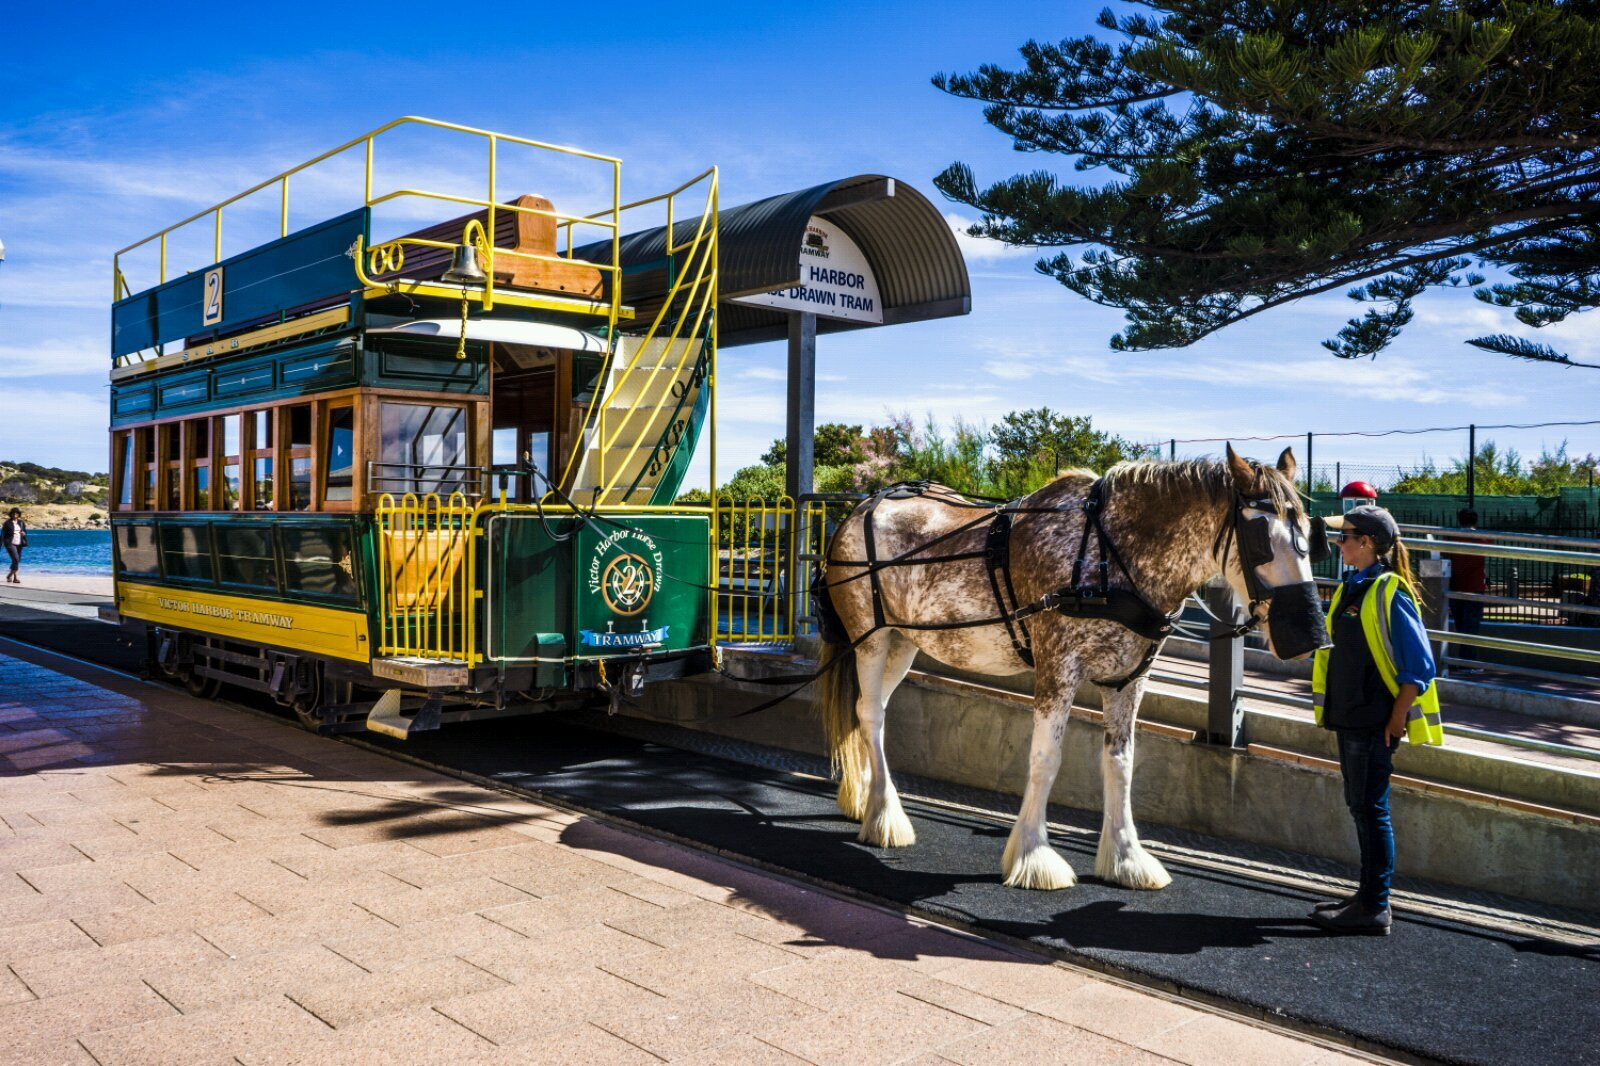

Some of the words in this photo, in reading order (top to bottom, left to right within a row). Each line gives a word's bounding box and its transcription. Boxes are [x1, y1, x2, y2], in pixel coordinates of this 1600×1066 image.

[800, 247, 830, 259] RAMWAY
[810, 265, 865, 290] HARBOR
[206, 272, 220, 320] 2
[790, 287, 836, 306] DRAWN
[839, 294, 873, 313] TRAM
[594, 529, 630, 556] Harbor
[588, 556, 602, 594] Victor
[622, 565, 637, 595] 2
[653, 551, 664, 592] Drawn
[159, 597, 190, 612] VICTOR
[192, 602, 234, 619] HARBOR
[236, 610, 293, 629] TRAMWAY
[594, 632, 658, 646] TRAMWAY
